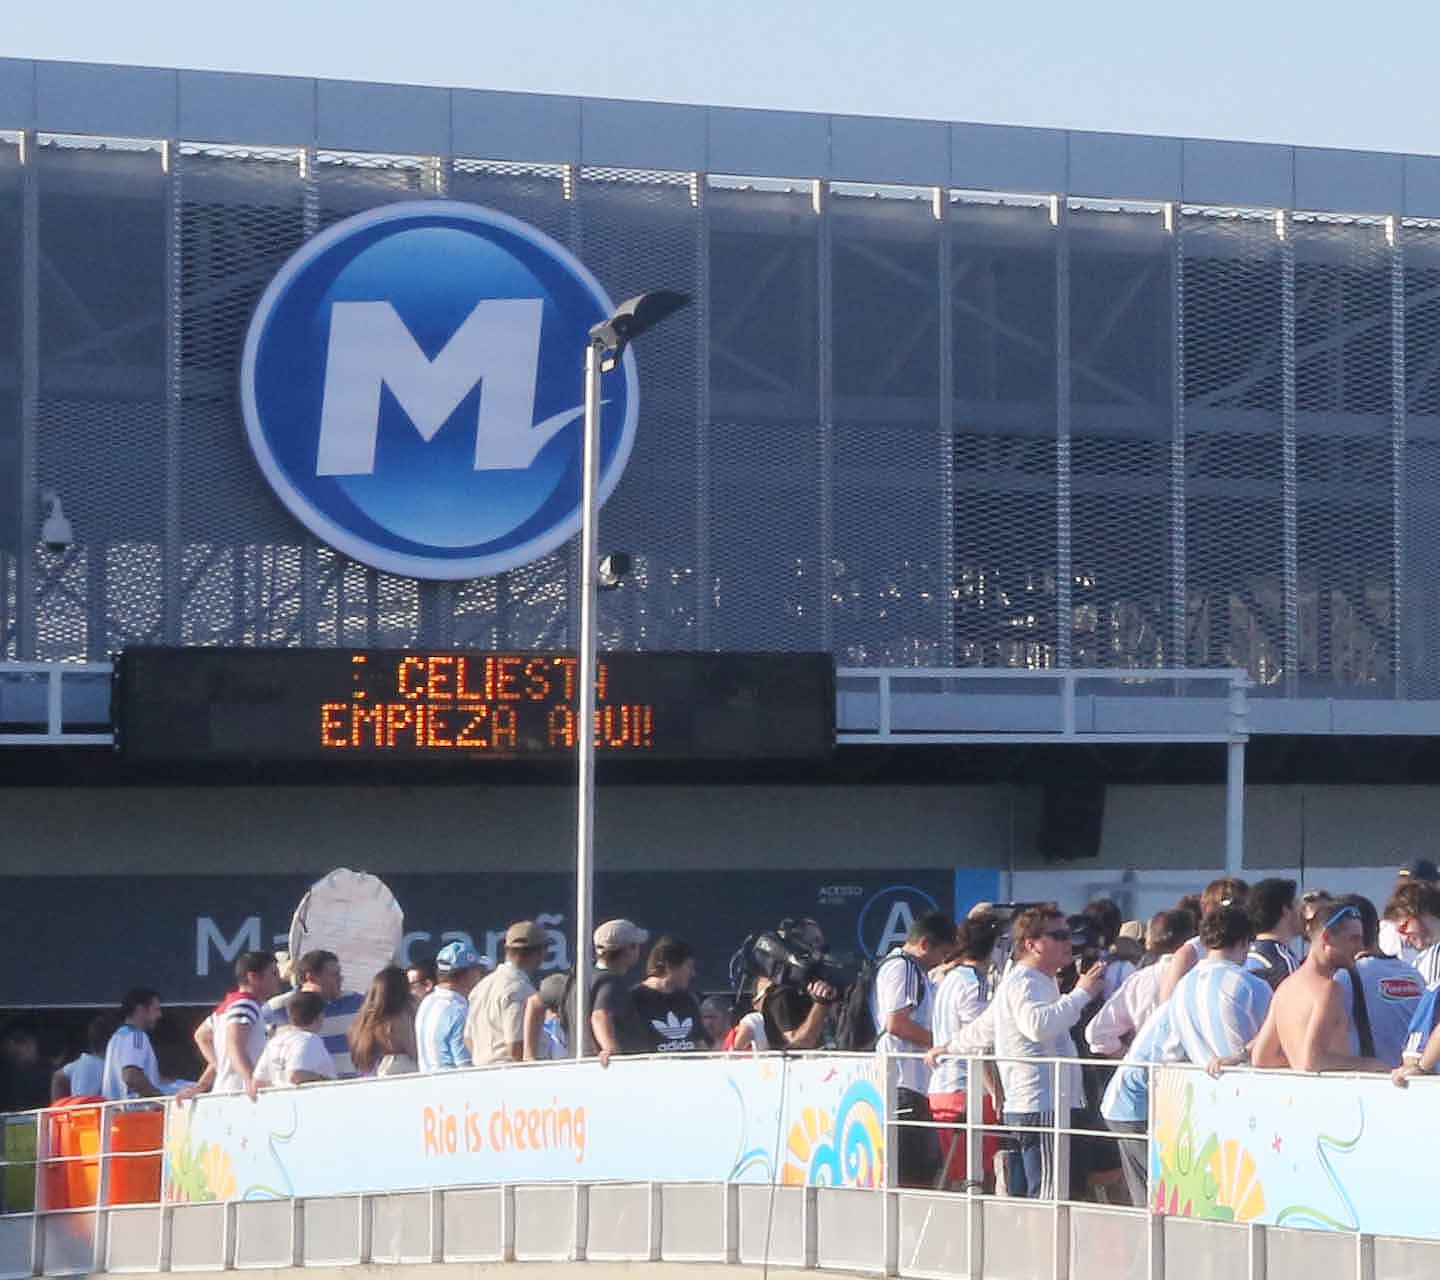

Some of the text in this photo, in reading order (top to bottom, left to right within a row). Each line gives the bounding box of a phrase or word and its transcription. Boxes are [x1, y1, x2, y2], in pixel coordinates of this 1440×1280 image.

[319, 703, 517, 747] EMPIEZA
[423, 1096, 587, 1163] Rio is cheering
